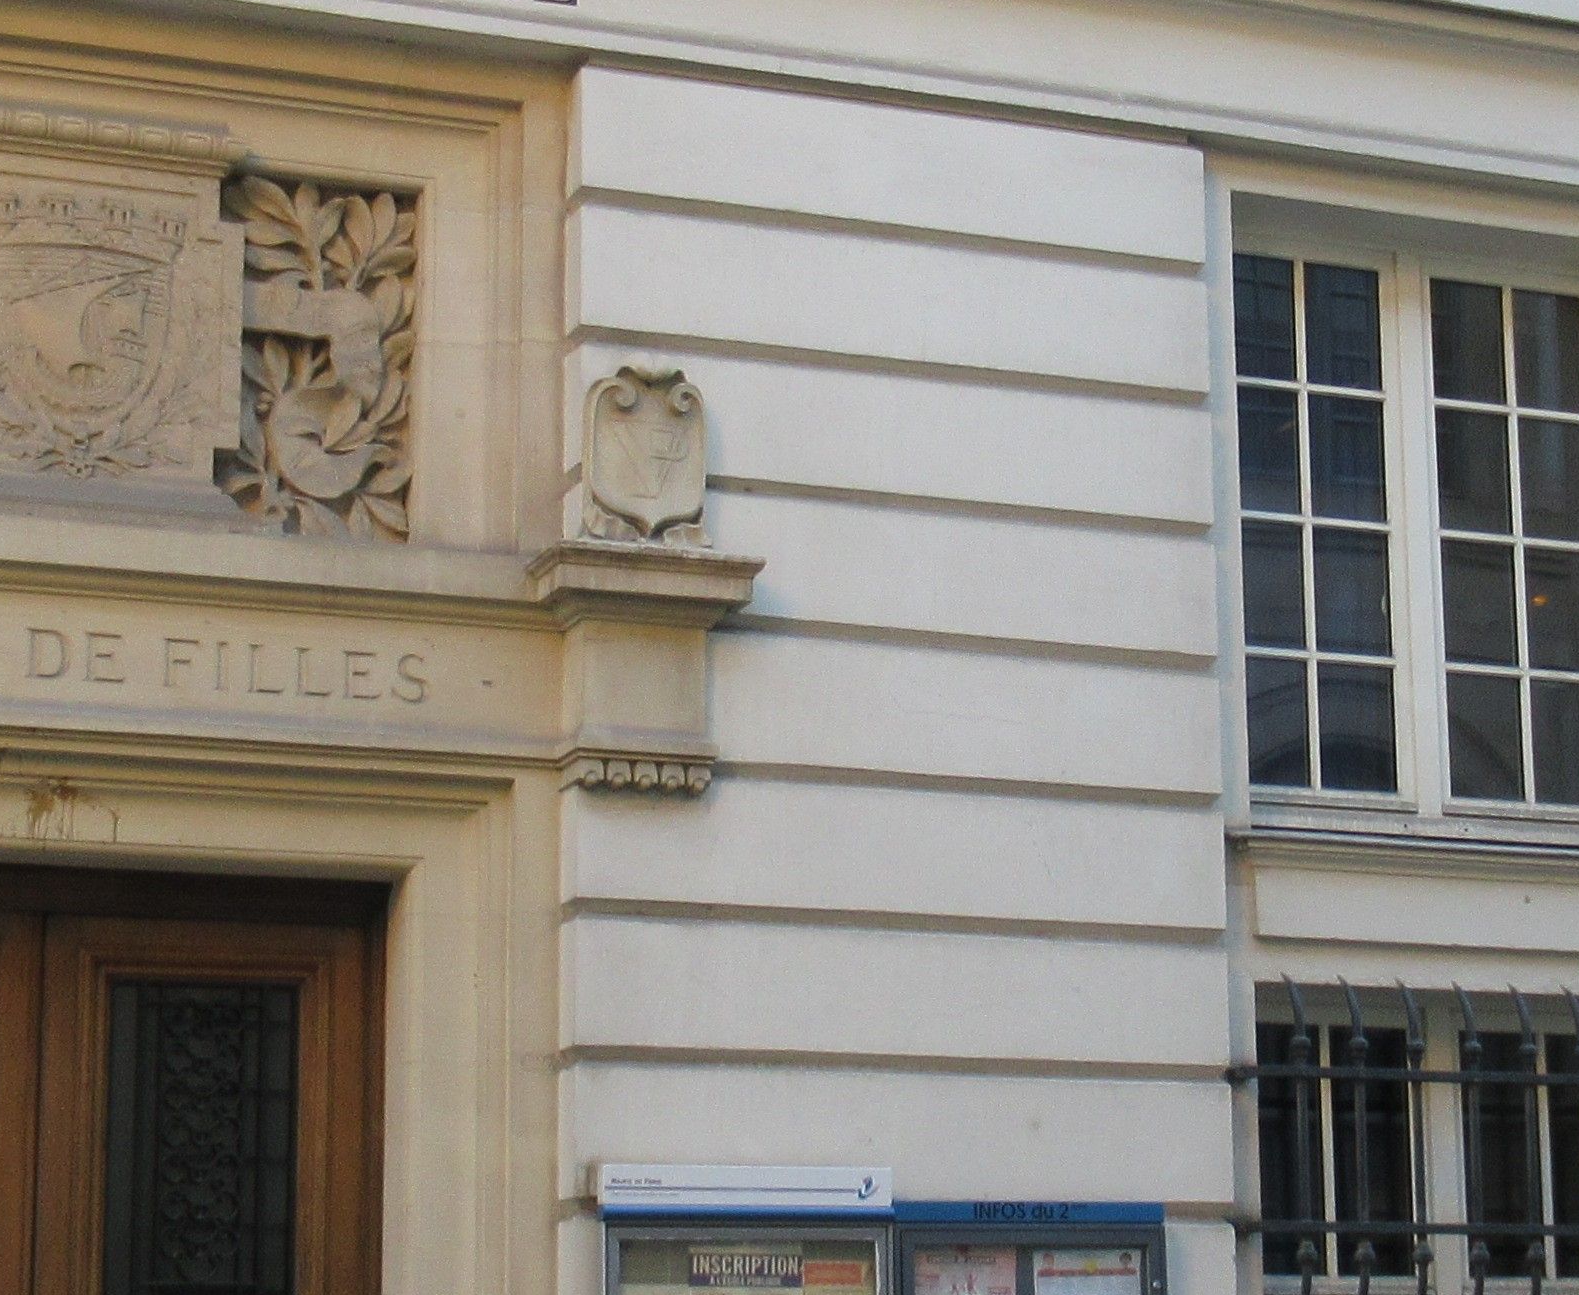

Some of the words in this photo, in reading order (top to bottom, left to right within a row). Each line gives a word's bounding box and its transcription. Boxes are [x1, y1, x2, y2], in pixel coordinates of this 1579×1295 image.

[25, 627, 124, 684] DE
[163, 636, 430, 704] FILLES
[973, 1203, 1026, 1220] INFOS
[1031, 1204, 1054, 1220] du
[693, 1254, 799, 1275] INSCRIPTION
